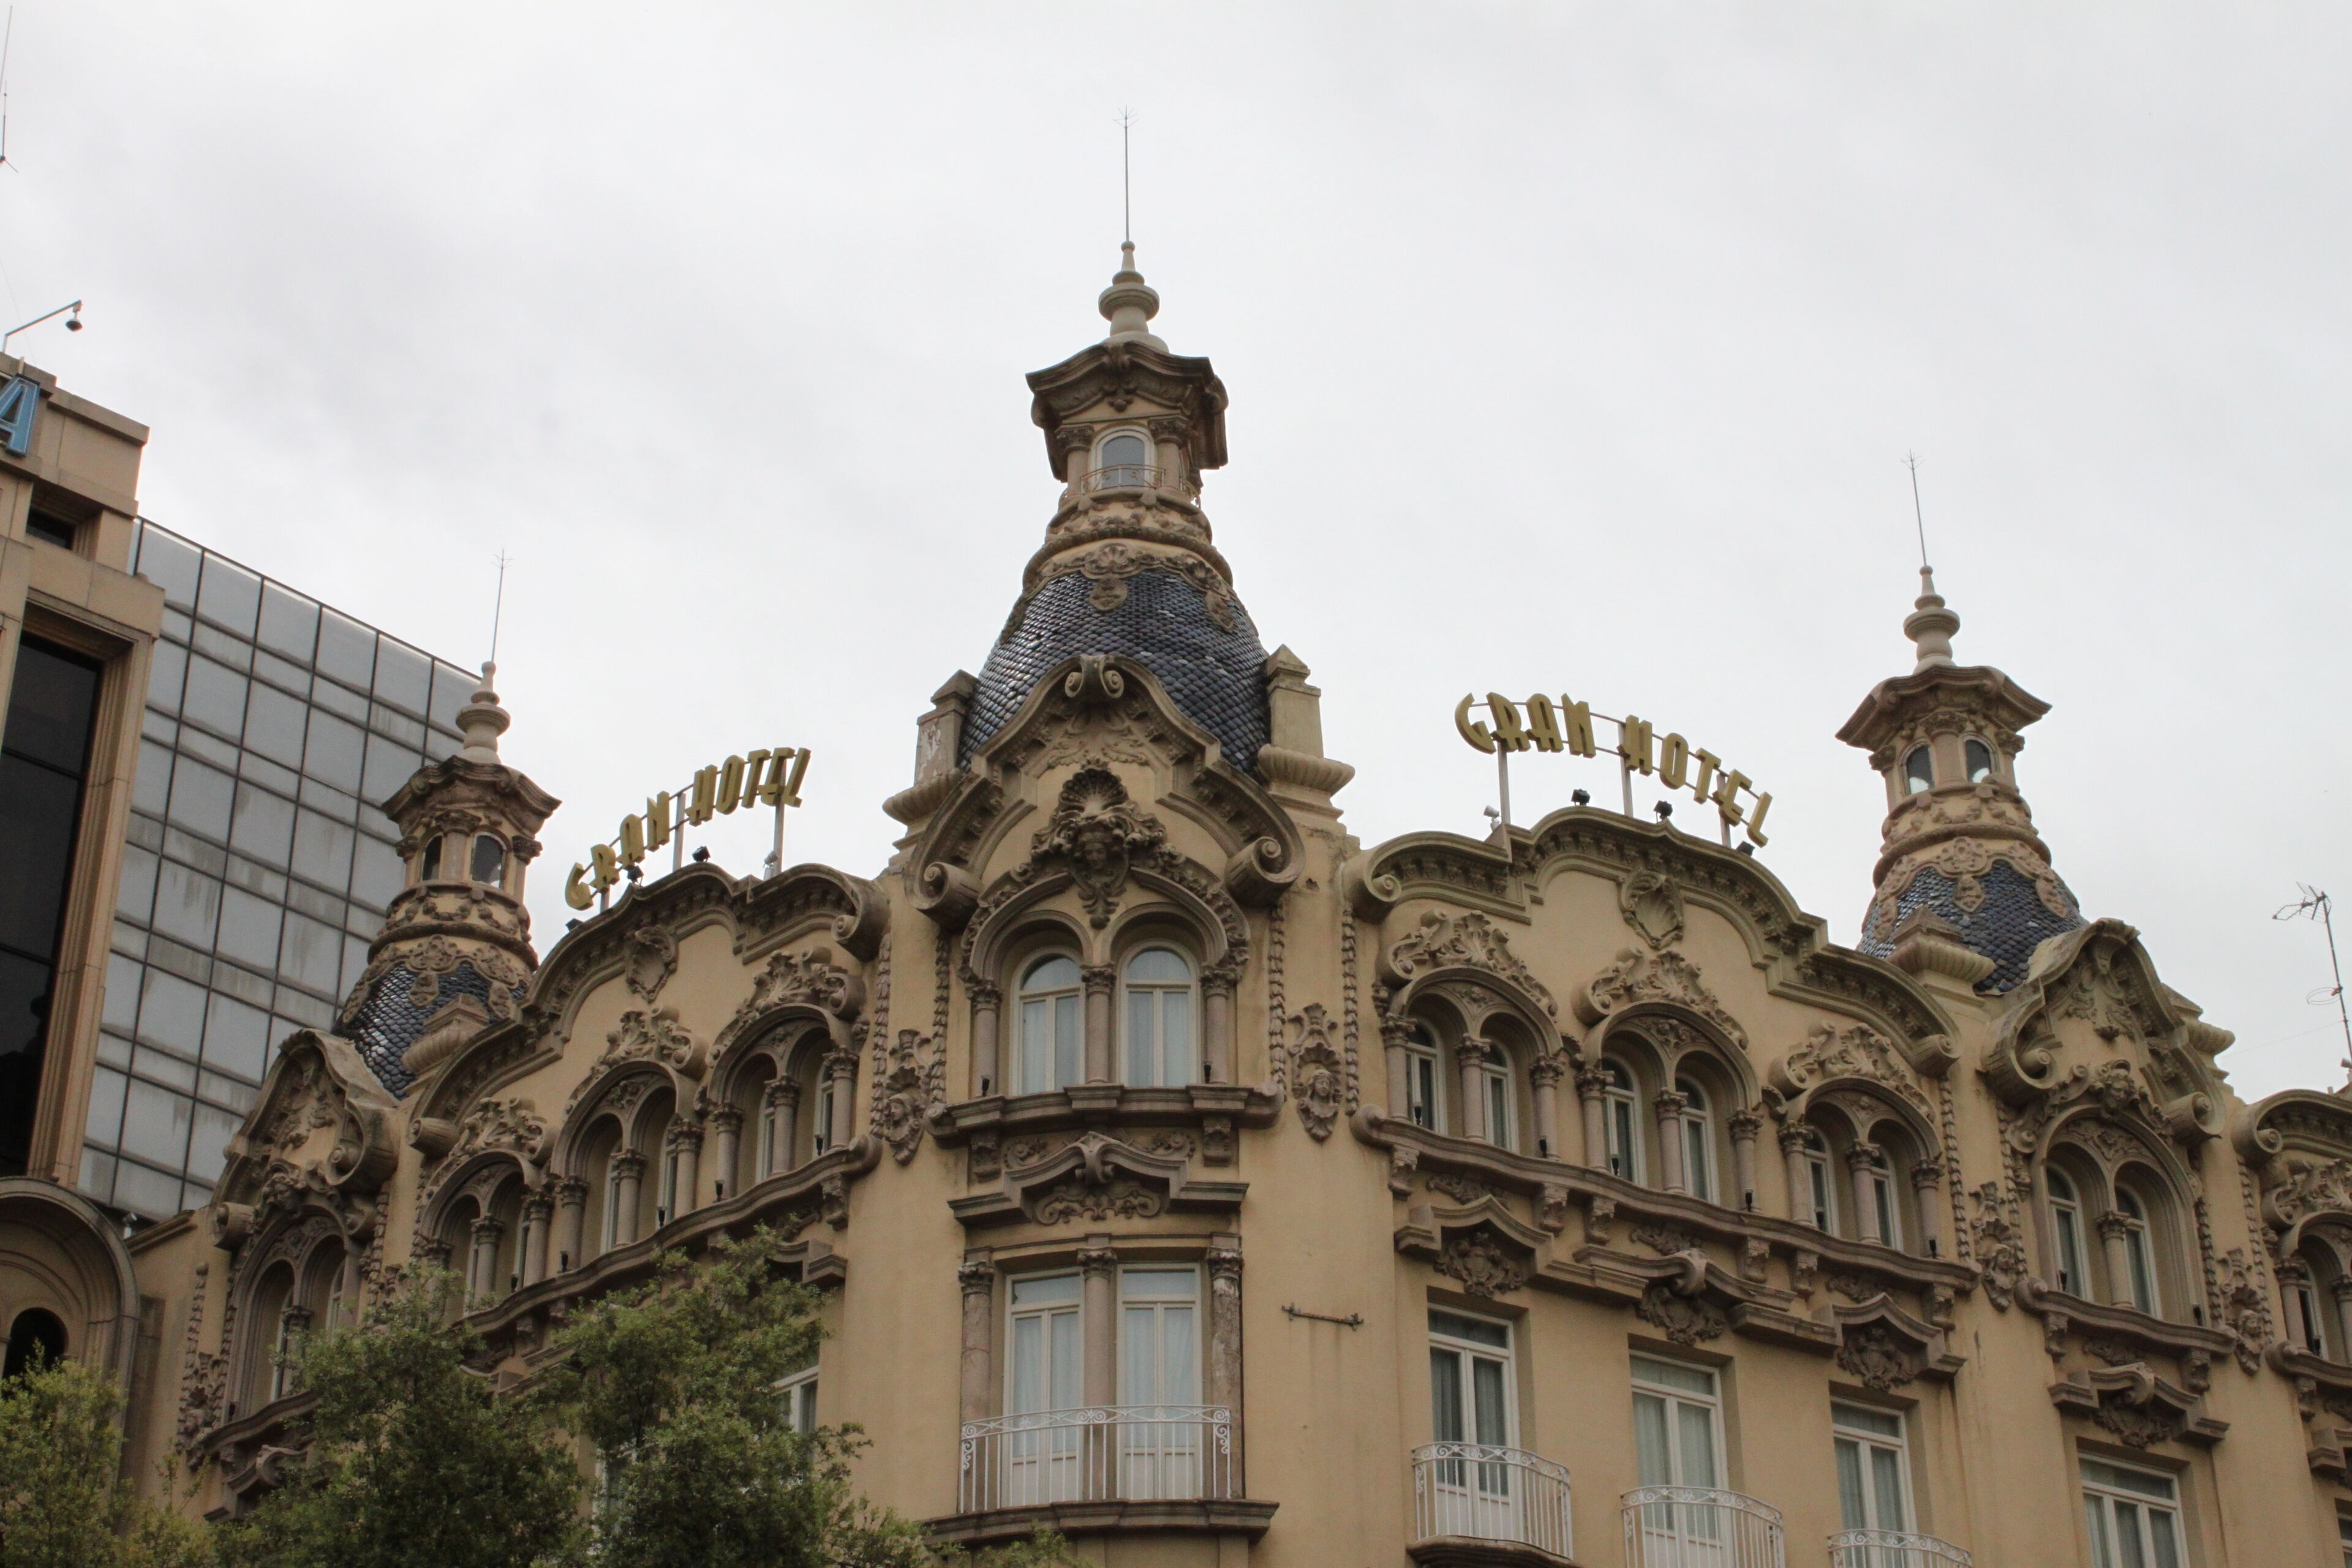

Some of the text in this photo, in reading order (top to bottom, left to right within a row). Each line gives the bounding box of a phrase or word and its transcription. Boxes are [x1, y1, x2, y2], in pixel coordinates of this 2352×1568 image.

[565, 747, 812, 911] GRAN HOTEL
[1455, 692, 1773, 847] GRAN HOTEL
